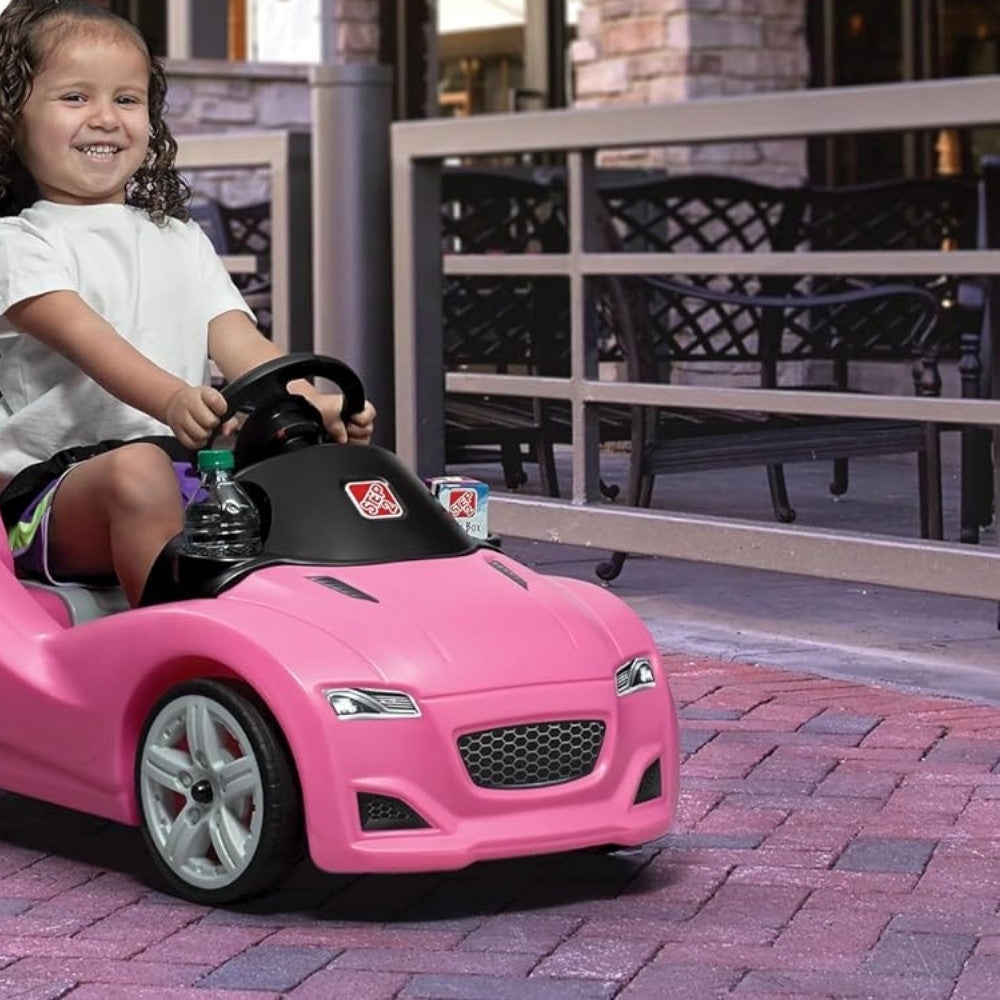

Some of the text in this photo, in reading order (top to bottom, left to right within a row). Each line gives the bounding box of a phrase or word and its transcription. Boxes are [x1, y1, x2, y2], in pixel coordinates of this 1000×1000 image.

[360, 483, 385, 515] STEP
[380, 500, 398, 514] 2
[450, 490, 474, 517] STEP
[464, 504, 475, 517] 2
